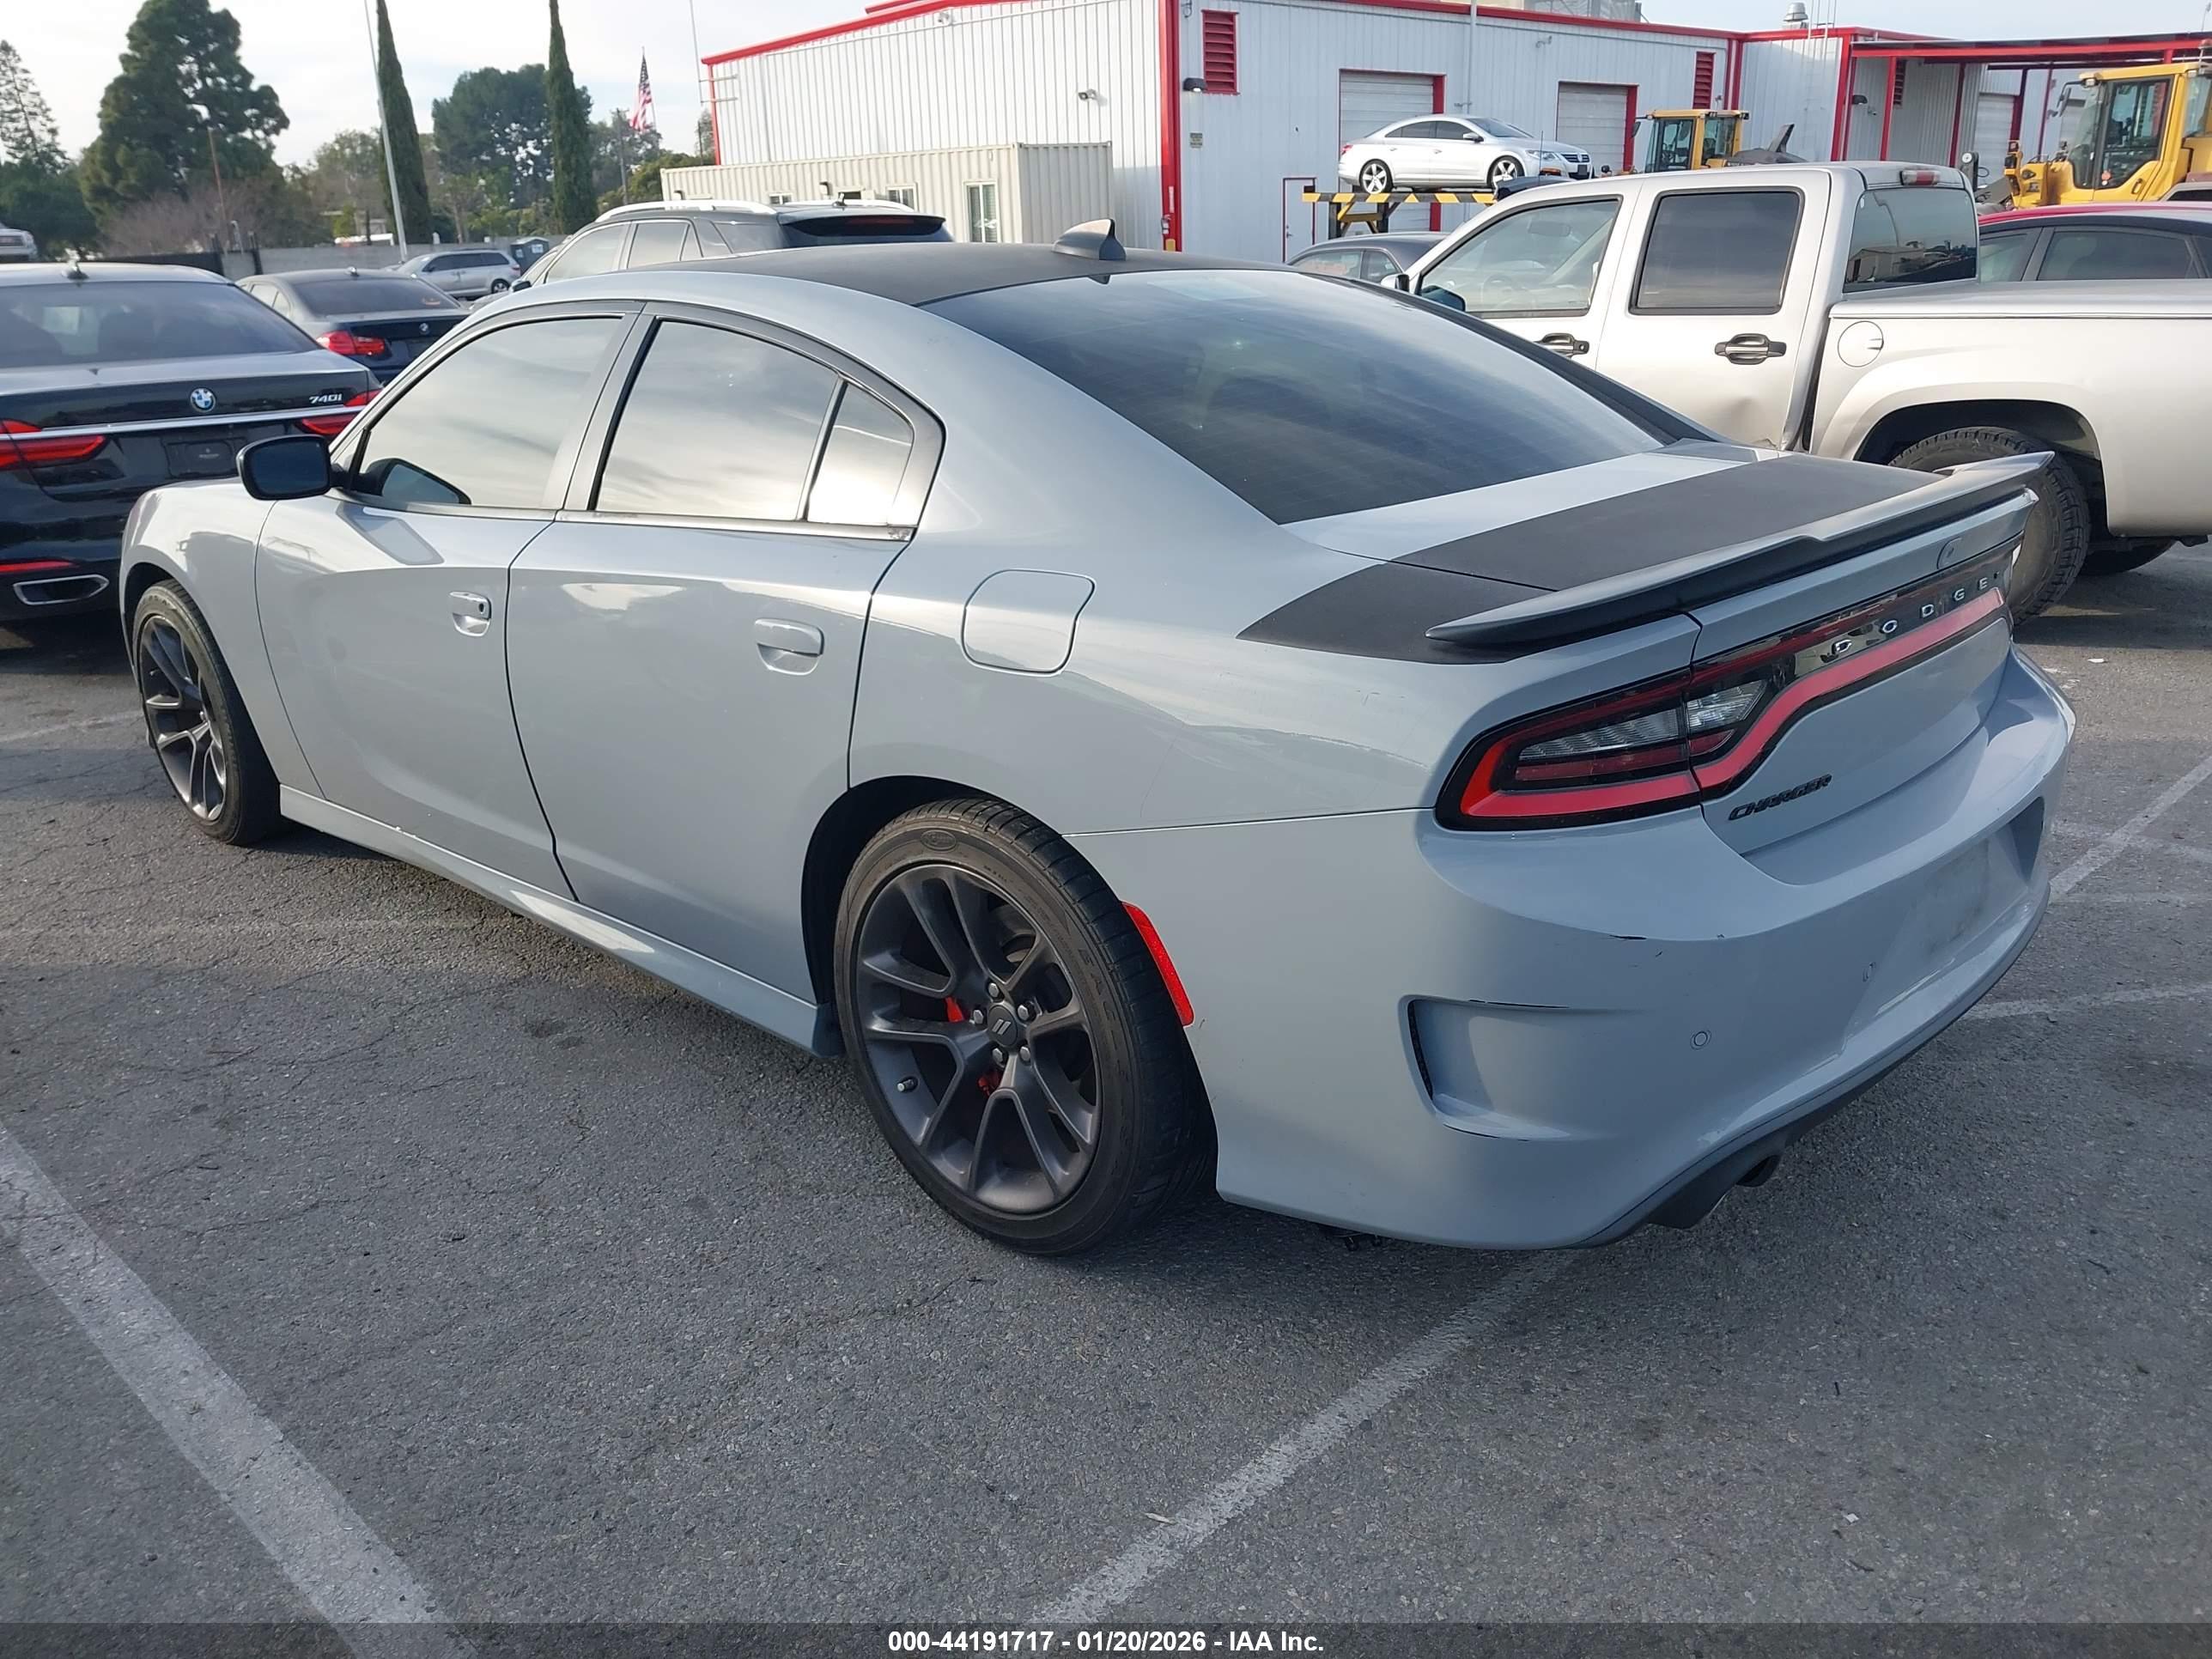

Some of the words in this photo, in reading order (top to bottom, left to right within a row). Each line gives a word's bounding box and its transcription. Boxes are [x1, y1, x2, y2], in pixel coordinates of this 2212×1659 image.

[308, 393, 343, 404] 740i
[1832, 577, 1989, 654] DODGE
[1728, 773, 1832, 821] CHARGER
